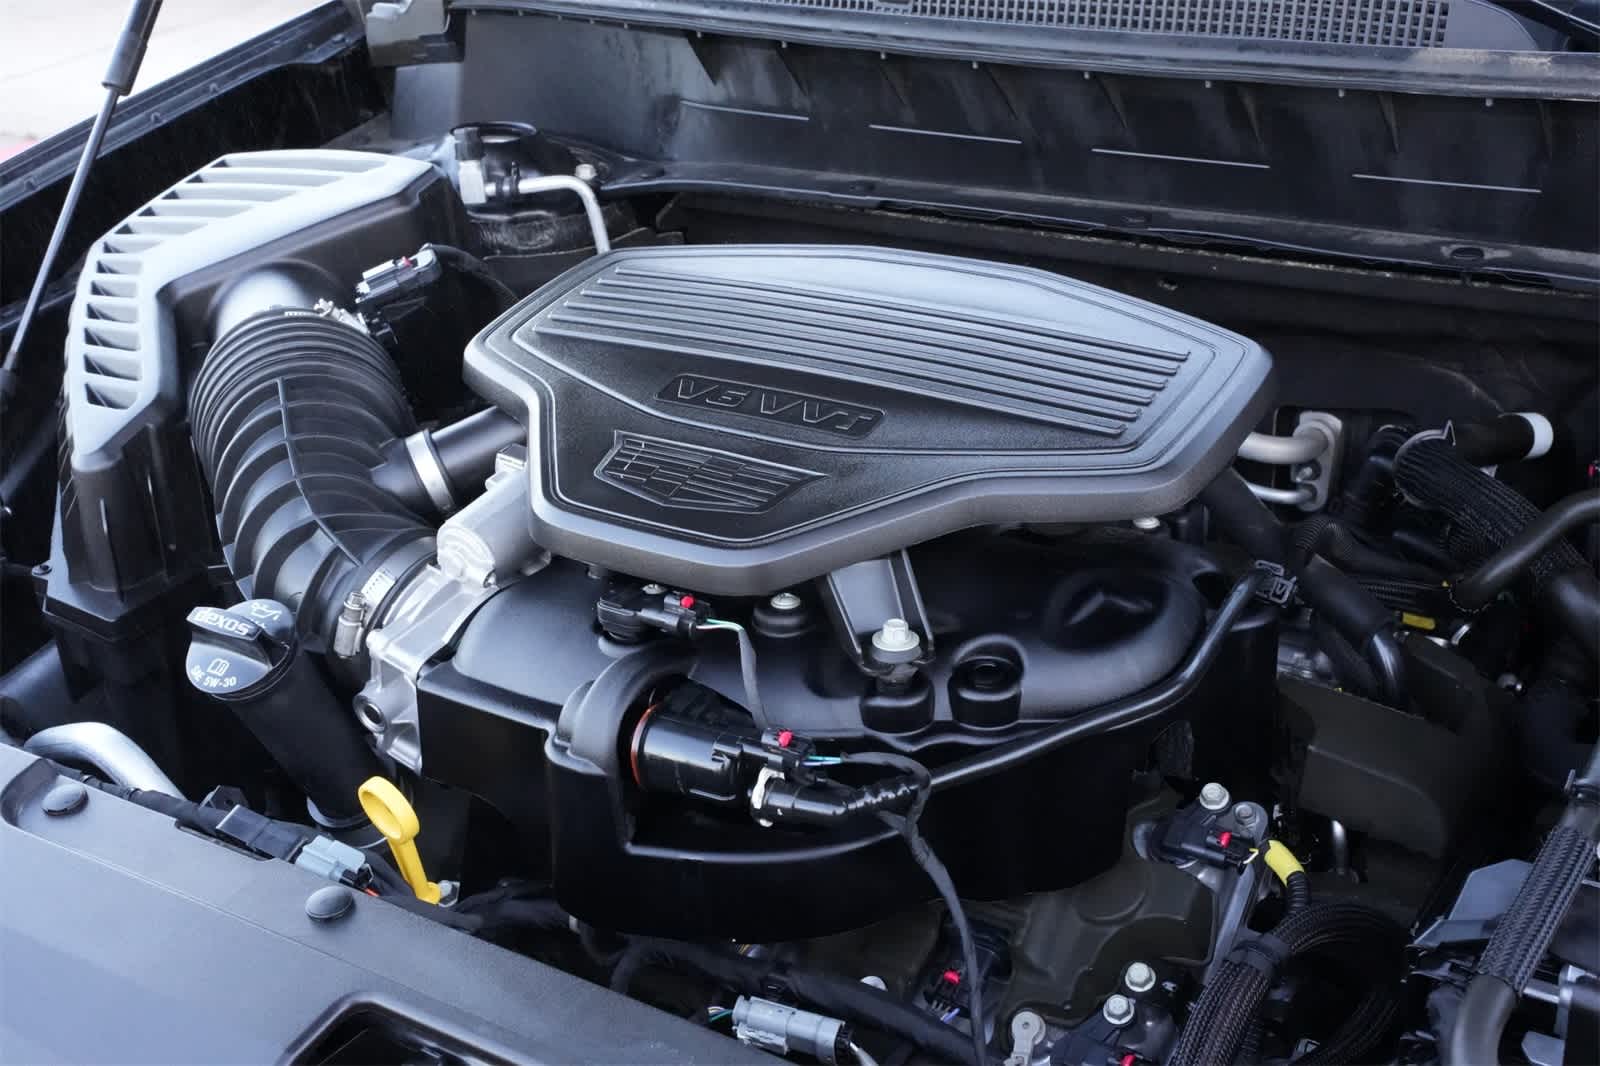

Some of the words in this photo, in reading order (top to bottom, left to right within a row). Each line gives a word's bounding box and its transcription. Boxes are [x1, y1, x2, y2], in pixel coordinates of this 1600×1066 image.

[677, 379, 752, 407] V6
[760, 391, 873, 430] VVT
[194, 610, 249, 636] dexos
[203, 676, 237, 688] 5W-30
